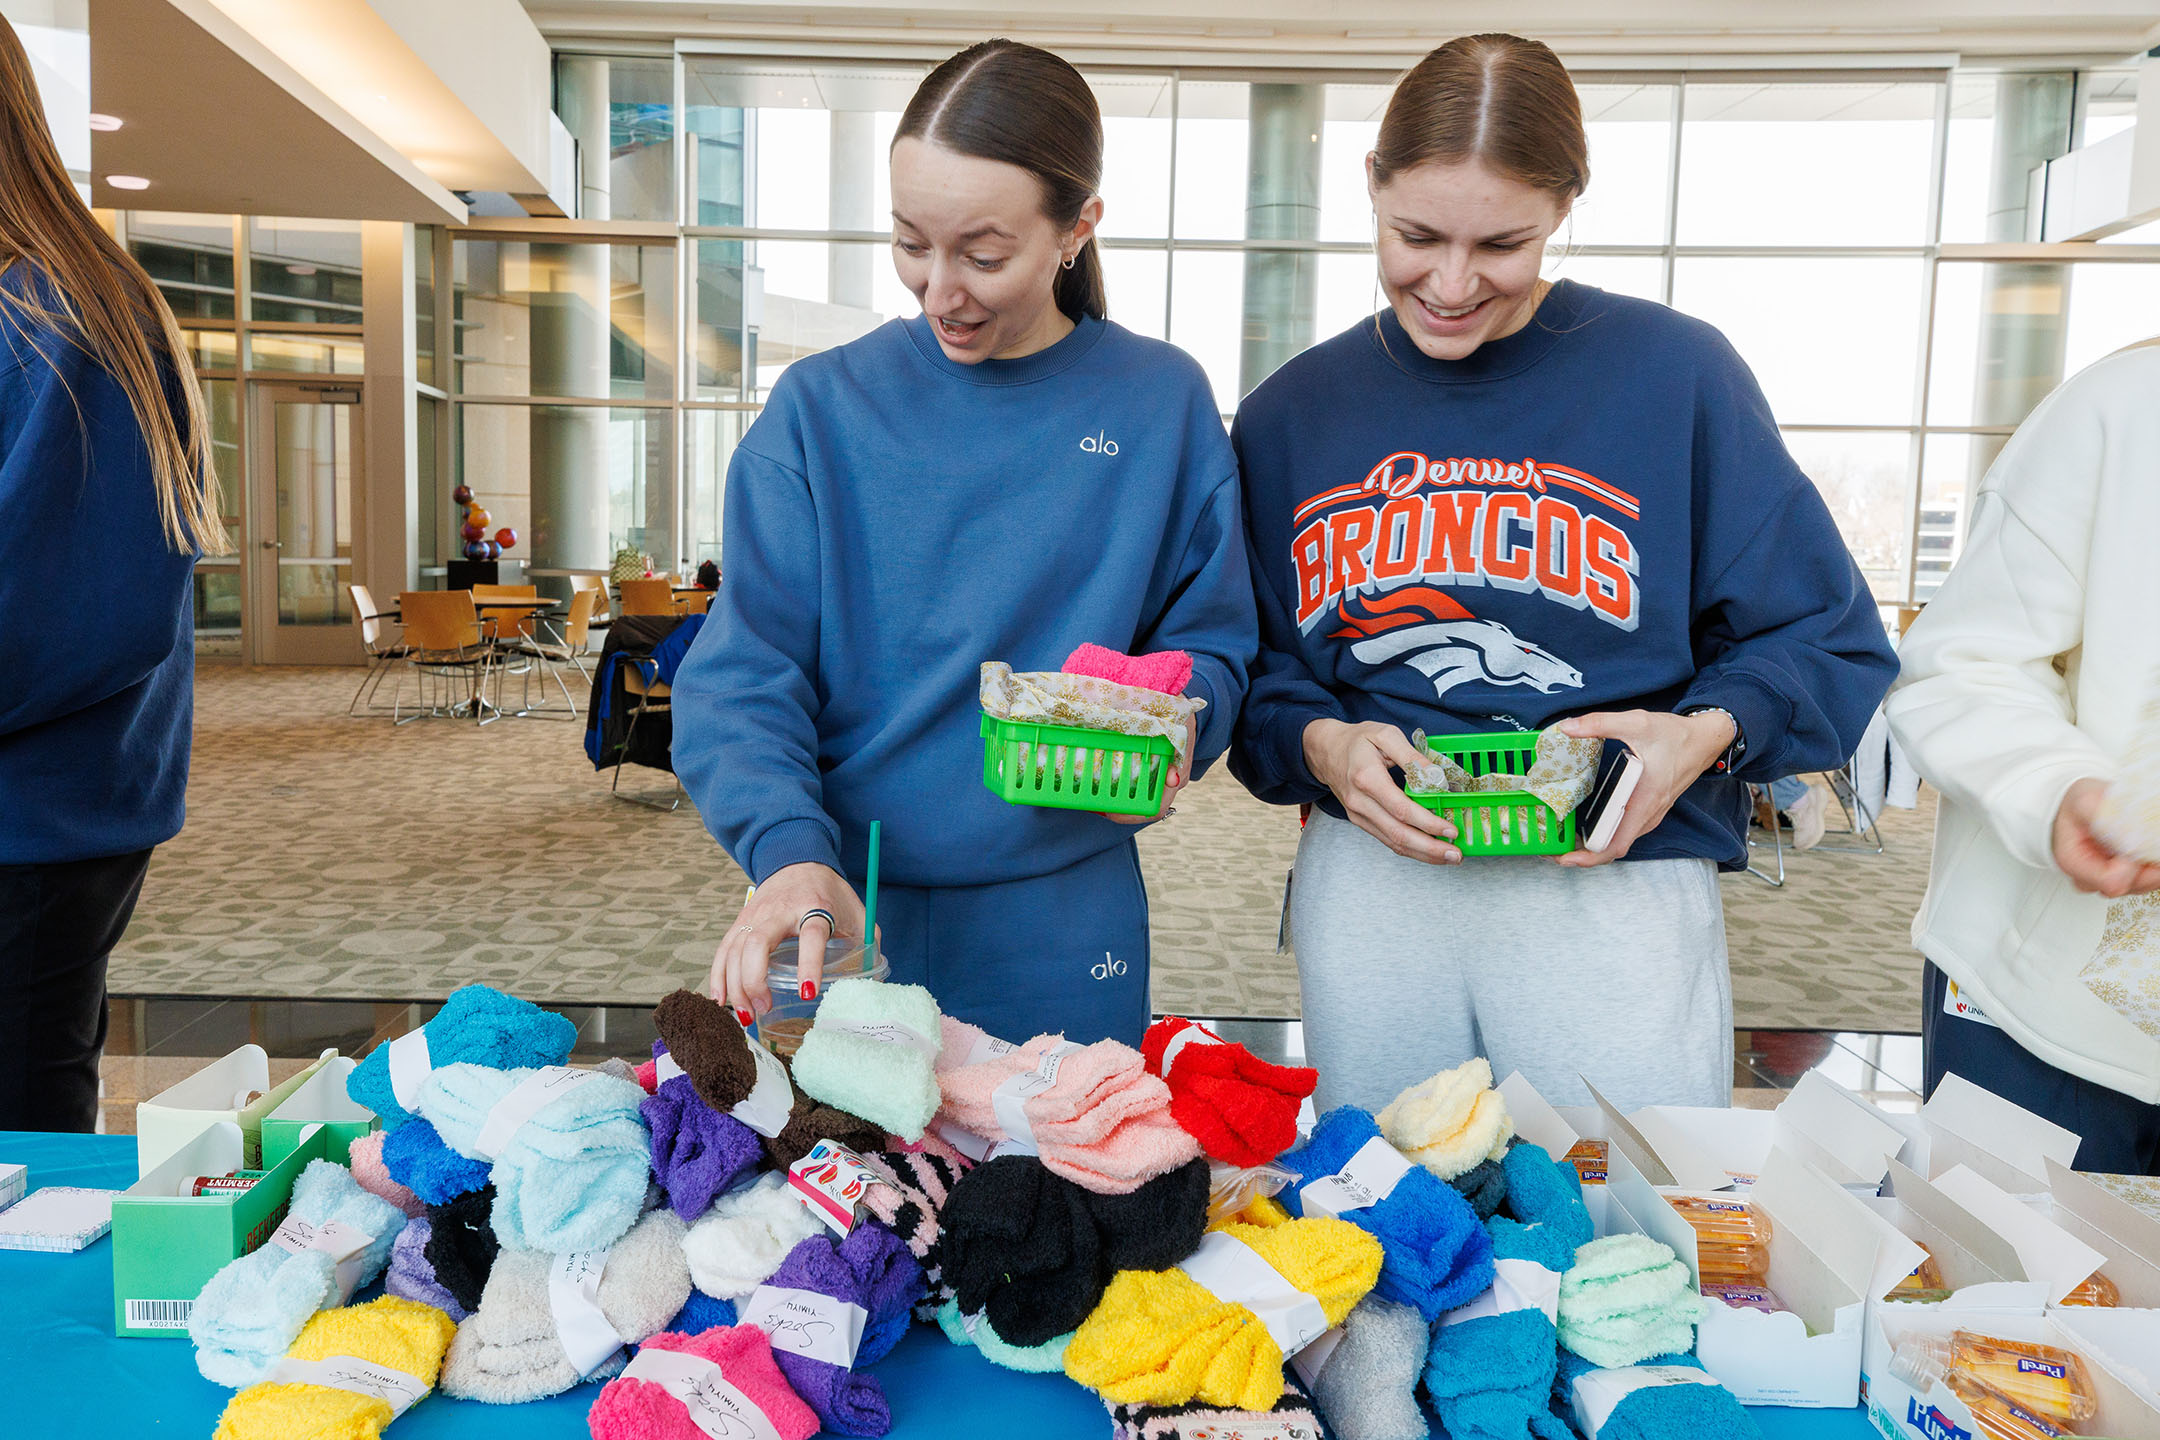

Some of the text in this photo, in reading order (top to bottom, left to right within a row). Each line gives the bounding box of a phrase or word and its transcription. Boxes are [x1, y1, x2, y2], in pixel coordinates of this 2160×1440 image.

[1080, 429, 1119, 456] alo
[1361, 451, 1547, 499] Denver
[1291, 490, 1640, 637] BRONCOS
[1090, 951, 1128, 980] alo
[206, 1178, 258, 1188] PERMINT
[786, 1302, 817, 1318] YIMIYU
[763, 1314, 836, 1349] Socks
[2021, 1360, 2063, 1379] Purell
[708, 1382, 741, 1415] YIMIYU
